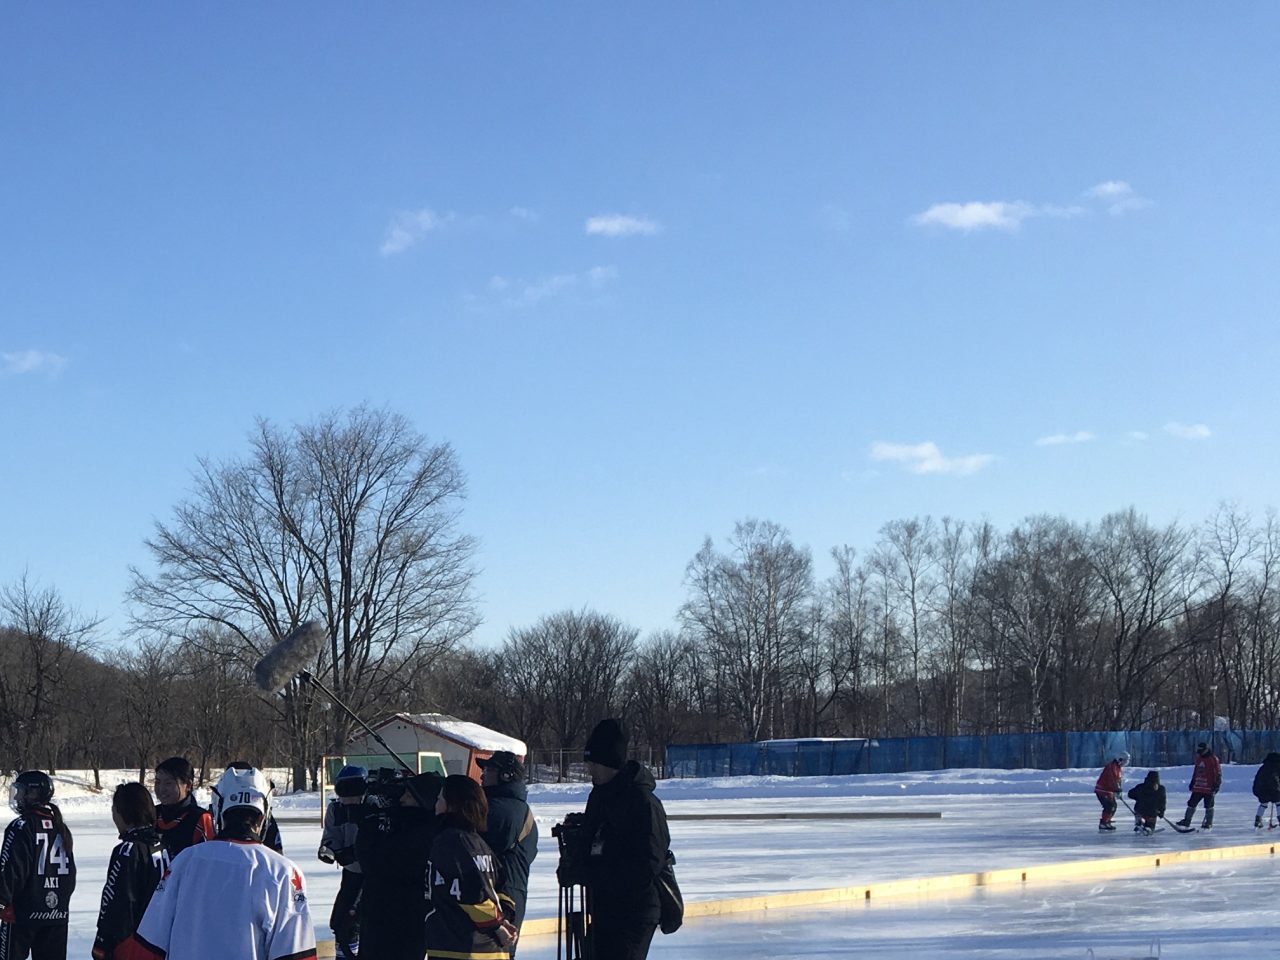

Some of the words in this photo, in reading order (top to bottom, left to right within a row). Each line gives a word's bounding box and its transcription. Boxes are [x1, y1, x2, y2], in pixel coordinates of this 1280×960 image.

[237, 791, 250, 804] 70
[35, 832, 70, 876] 74
[43, 876, 60, 889] AKI
